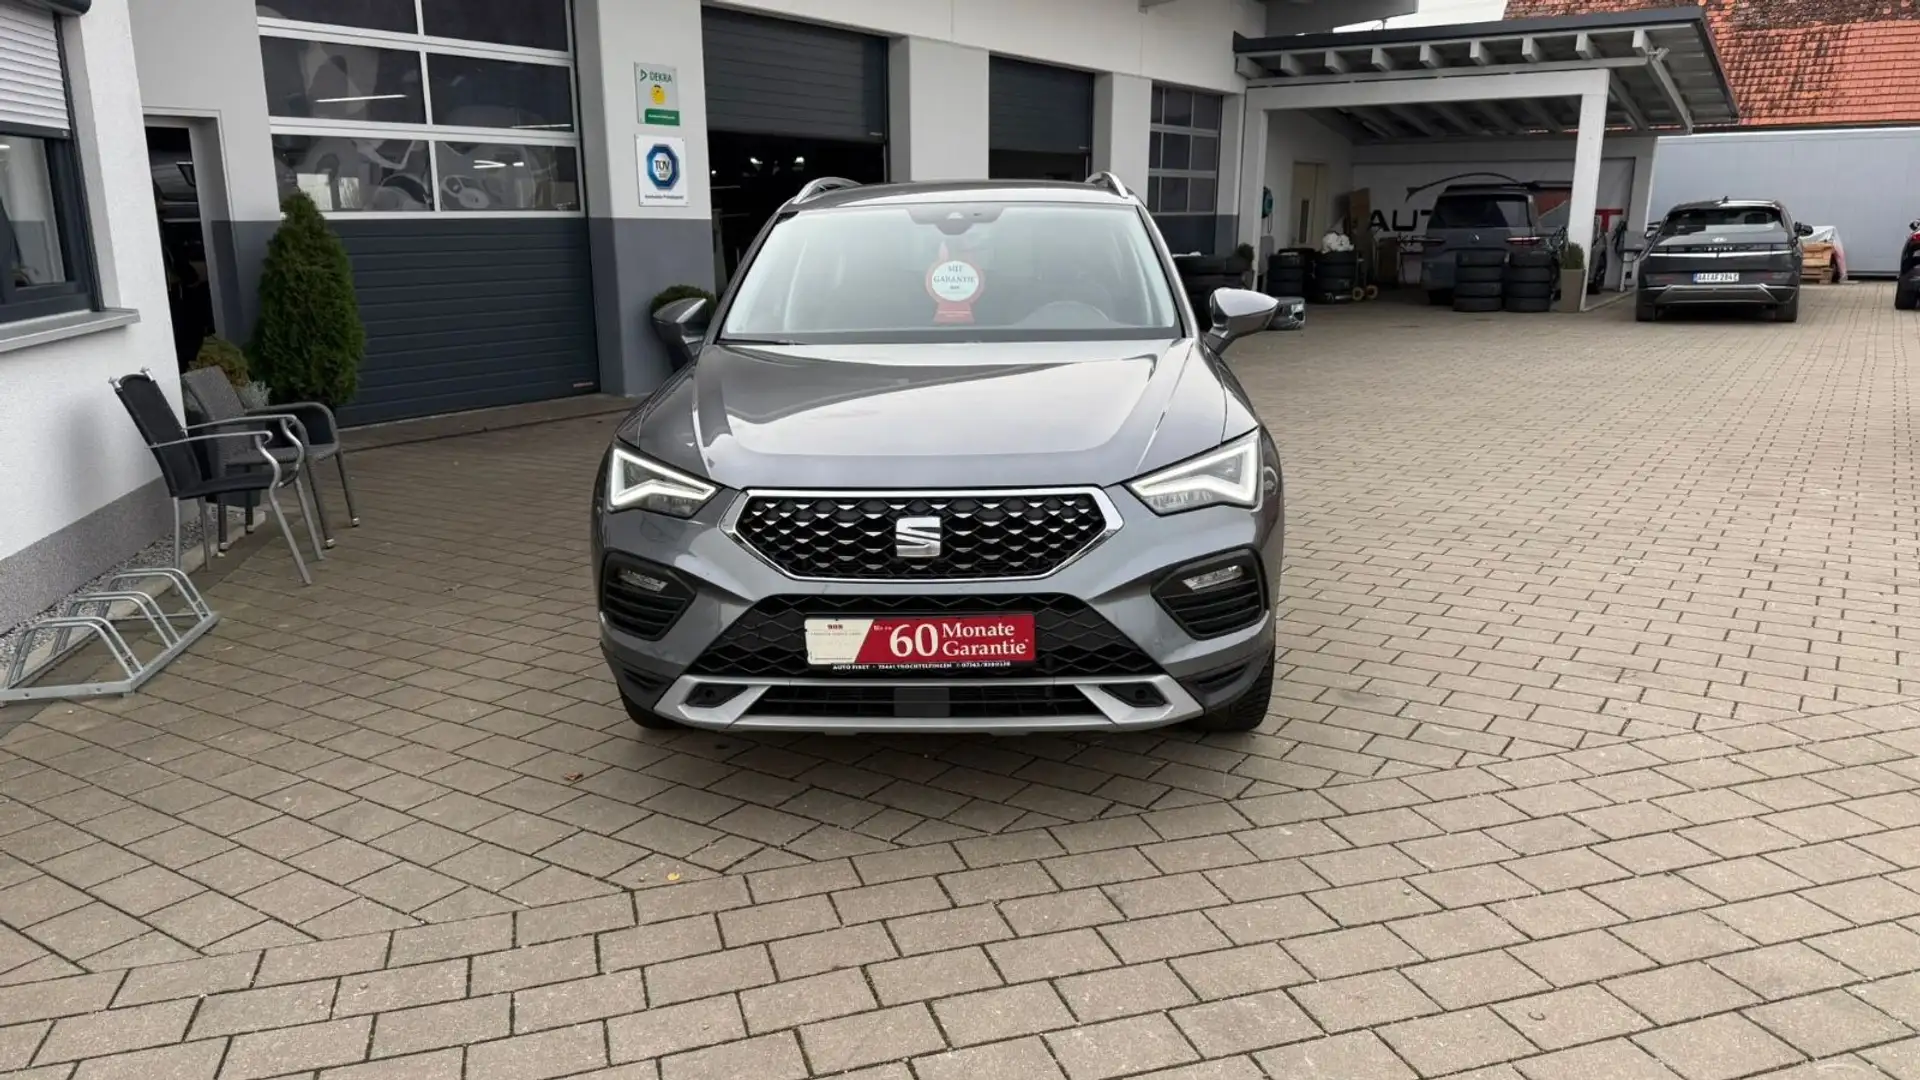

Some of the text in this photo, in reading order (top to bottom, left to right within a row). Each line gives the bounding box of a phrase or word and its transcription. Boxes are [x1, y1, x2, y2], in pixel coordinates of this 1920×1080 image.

[649, 71, 673, 83] DEKRA
[1369, 208, 1434, 233] AU
[889, 621, 1016, 658] 60 Monate
